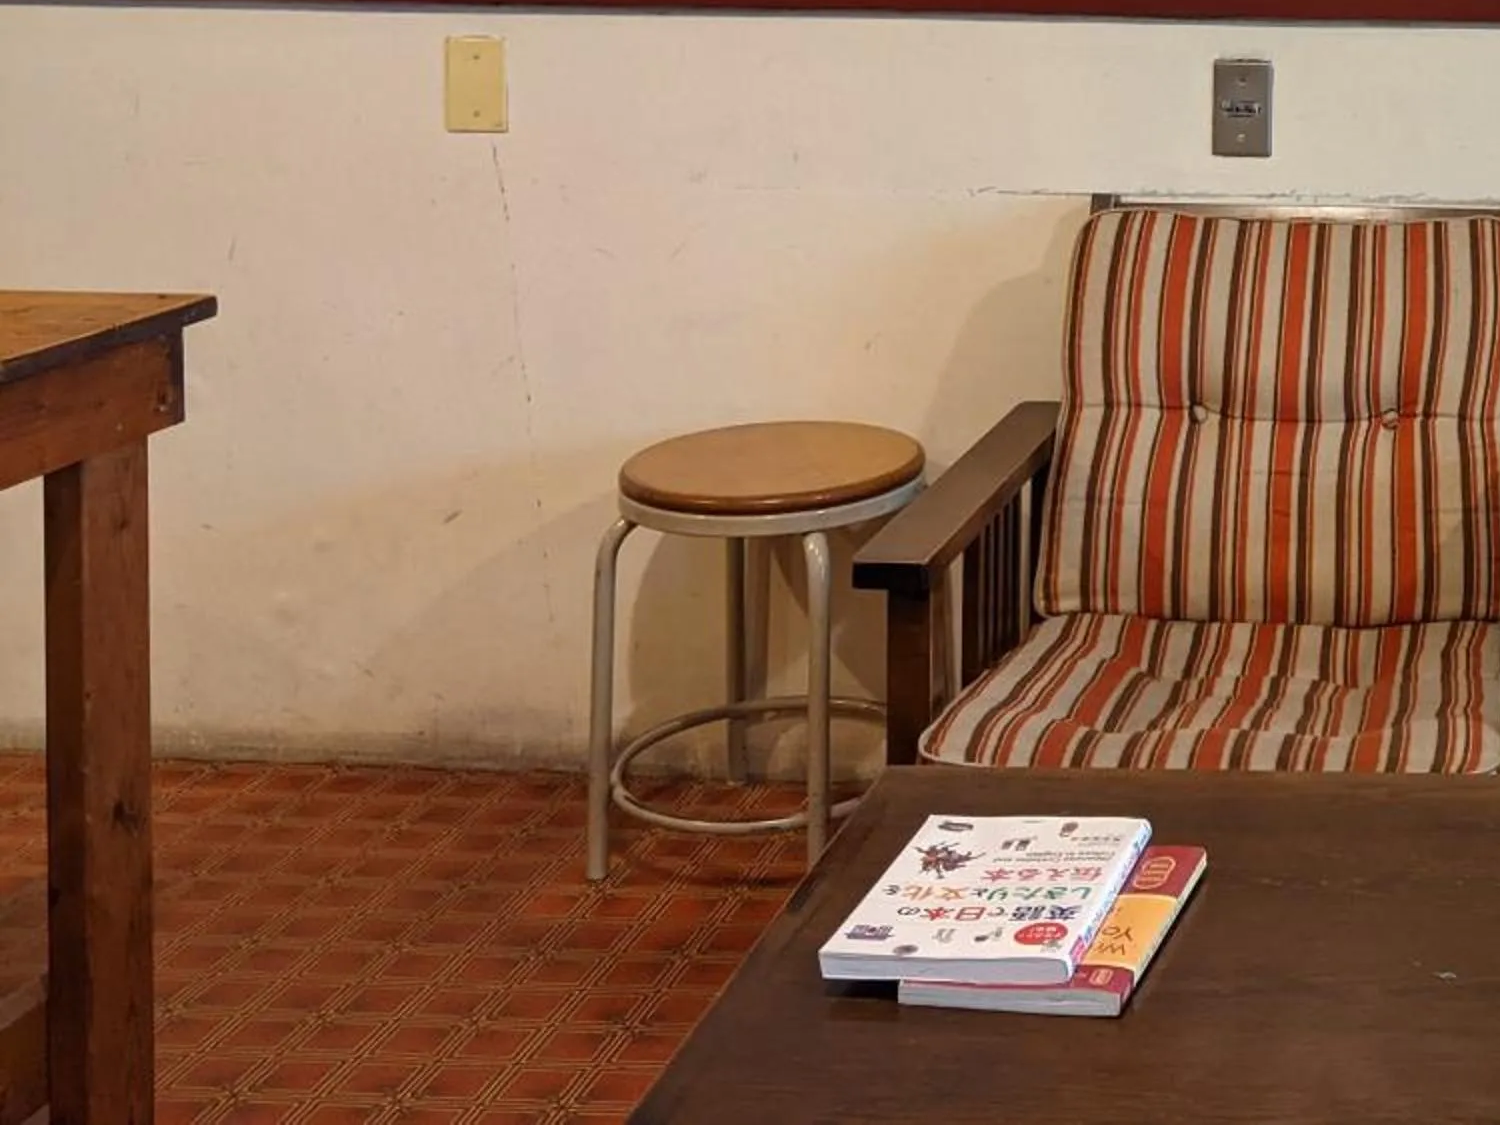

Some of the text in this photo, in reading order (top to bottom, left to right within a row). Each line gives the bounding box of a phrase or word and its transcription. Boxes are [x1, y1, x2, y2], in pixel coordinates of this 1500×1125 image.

[981, 866, 1103, 882] 伝える本
[884, 884, 1093, 900] しきたりと文化を
[897, 906, 1082, 922] 英語で日本の
